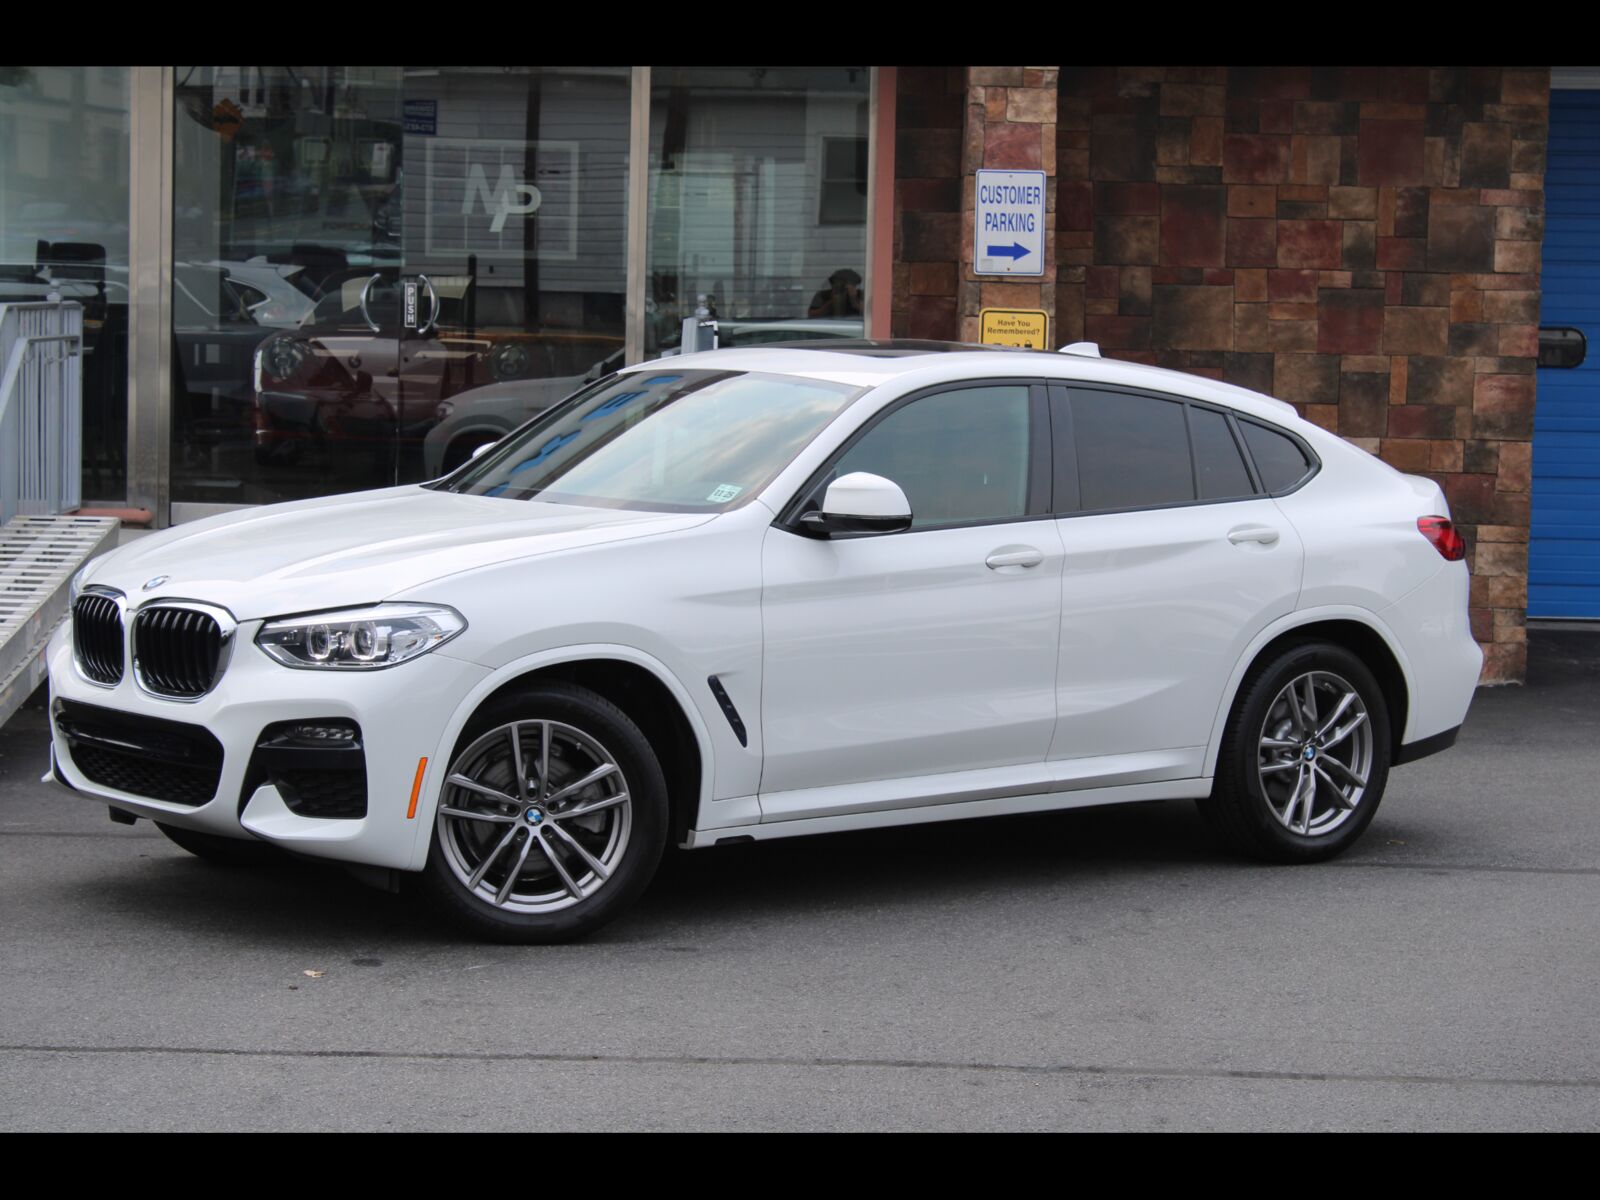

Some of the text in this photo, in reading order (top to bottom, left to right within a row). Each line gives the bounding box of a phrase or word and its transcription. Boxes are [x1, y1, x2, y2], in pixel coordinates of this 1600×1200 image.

[980, 185, 1041, 205] CUSTOMER
[985, 212, 1035, 232] PARKING
[407, 287, 415, 323] PUSH
[987, 327, 1040, 336] Remembered?
[997, 319, 1031, 328] Have You
